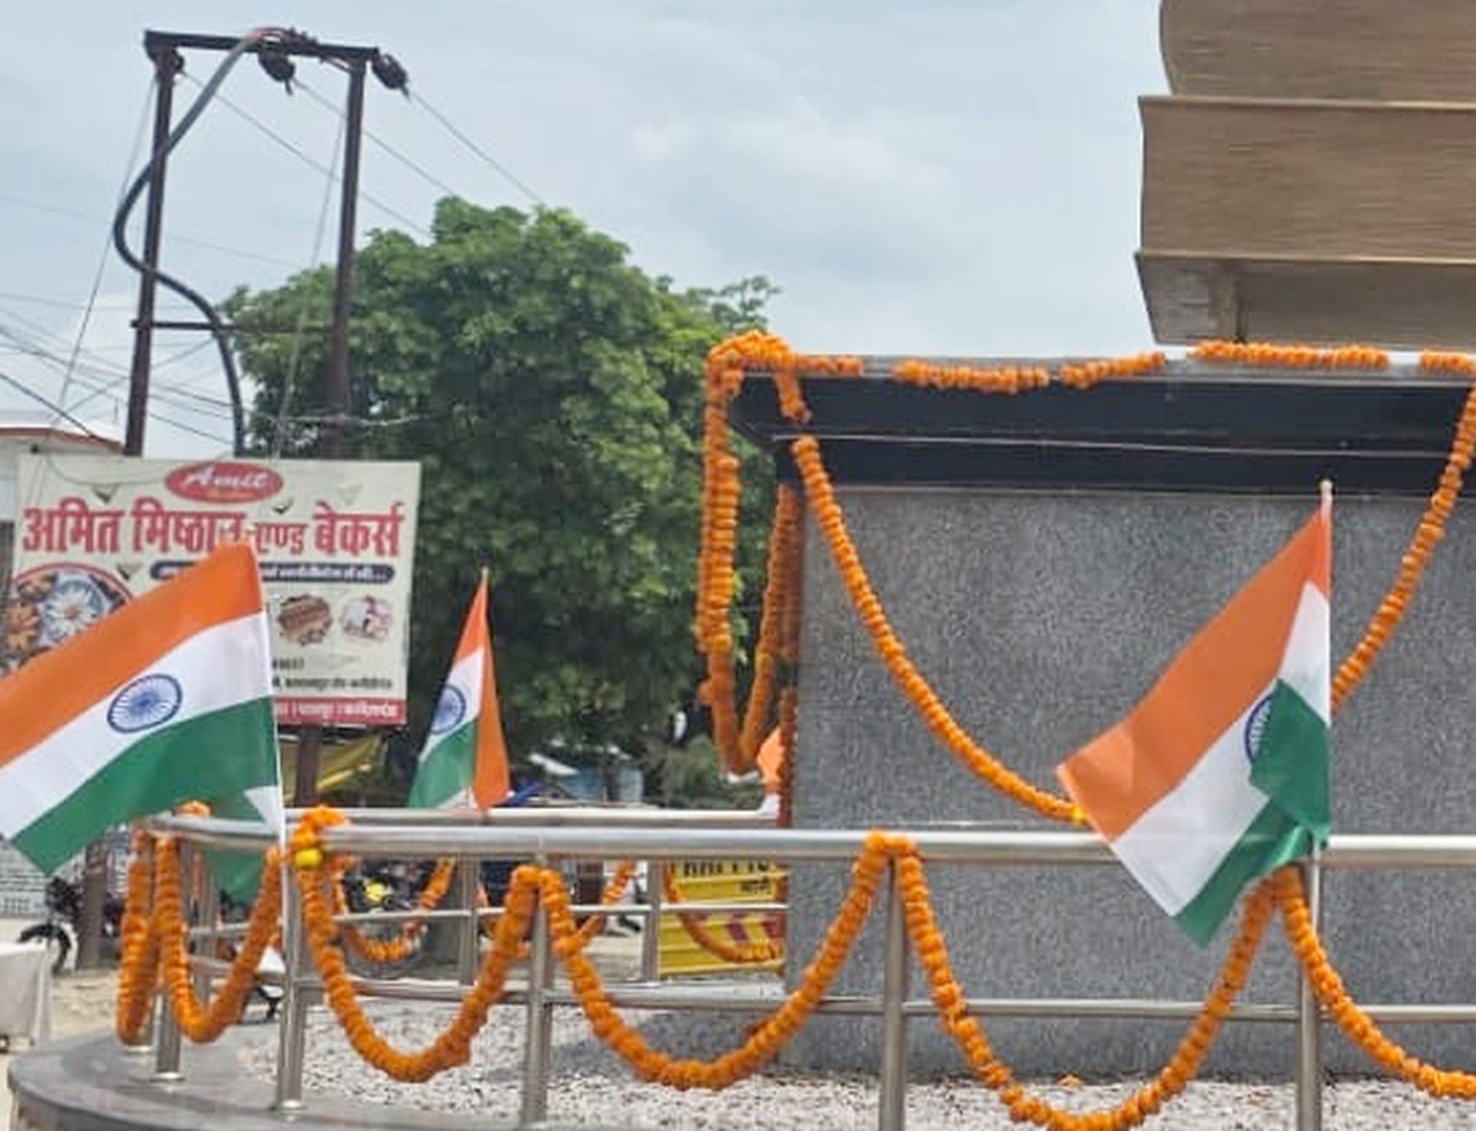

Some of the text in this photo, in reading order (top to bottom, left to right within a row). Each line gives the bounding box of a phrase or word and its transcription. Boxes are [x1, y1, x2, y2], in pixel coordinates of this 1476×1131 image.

[183, 466, 268, 489] Amit
[22, 497, 124, 553] अमित
[313, 500, 404, 557] बेकर्स
